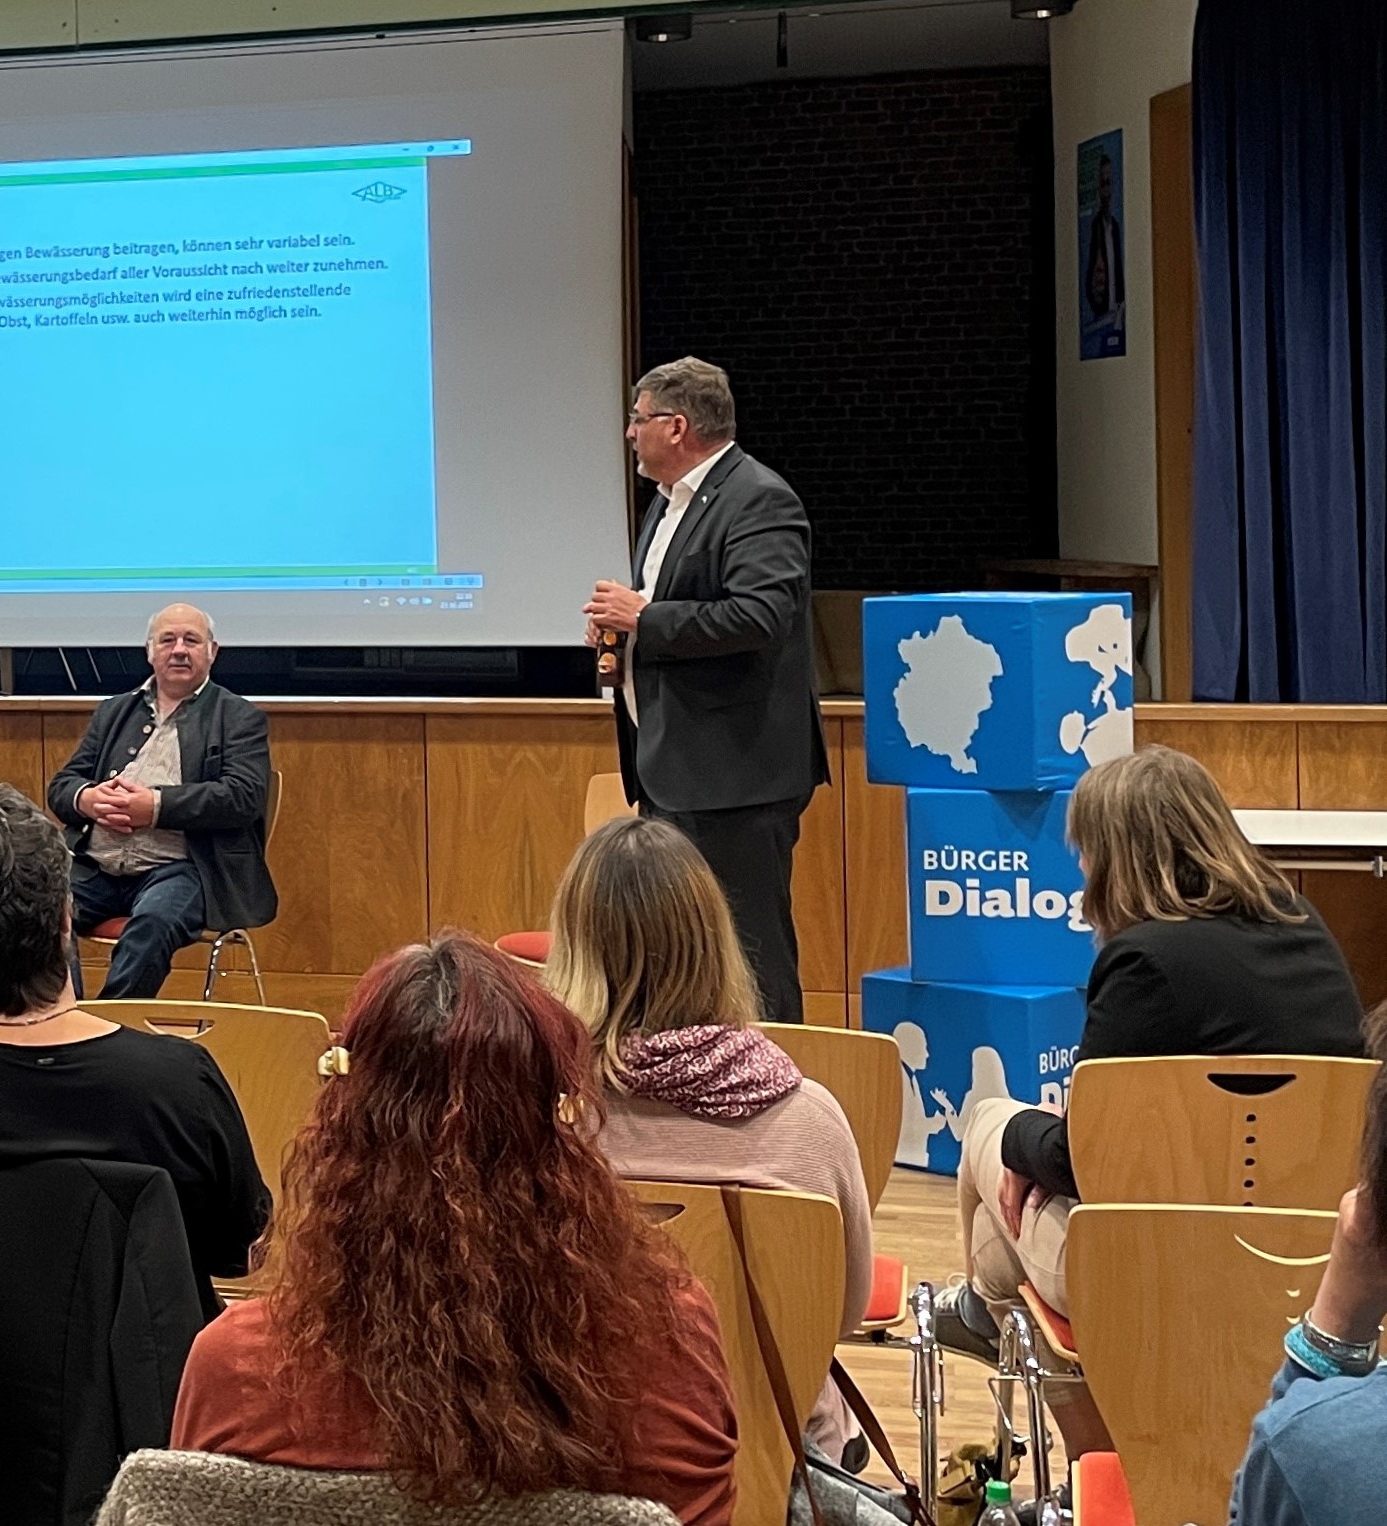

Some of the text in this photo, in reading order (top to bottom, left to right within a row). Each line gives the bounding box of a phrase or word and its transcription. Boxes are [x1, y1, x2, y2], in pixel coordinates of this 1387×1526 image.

[25, 246, 110, 259] Bewässerung
[113, 243, 179, 256] beitragen,
[182, 240, 232, 253] können
[235, 237, 264, 250] sehr
[267, 234, 320, 248] variabel
[323, 234, 355, 246] sein.
[121, 266, 149, 279] aller
[152, 263, 228, 278] Voraussicht
[232, 262, 263, 275] nach
[267, 261, 310, 274] weiter
[312, 258, 388, 272] zunehmen.
[163, 289, 191, 302] wird
[196, 288, 223, 301] eine
[227, 283, 351, 300] zufriedenstellende
[35, 312, 98, 327] Kartoffeln
[102, 313, 130, 325] usw.
[134, 310, 165, 324] auch
[168, 308, 231, 322] weiterhin
[235, 305, 287, 322] möglich
[291, 304, 322, 318] sein.
[923, 845, 1029, 872] BÜRGER
[924, 878, 1092, 931] Dialog
